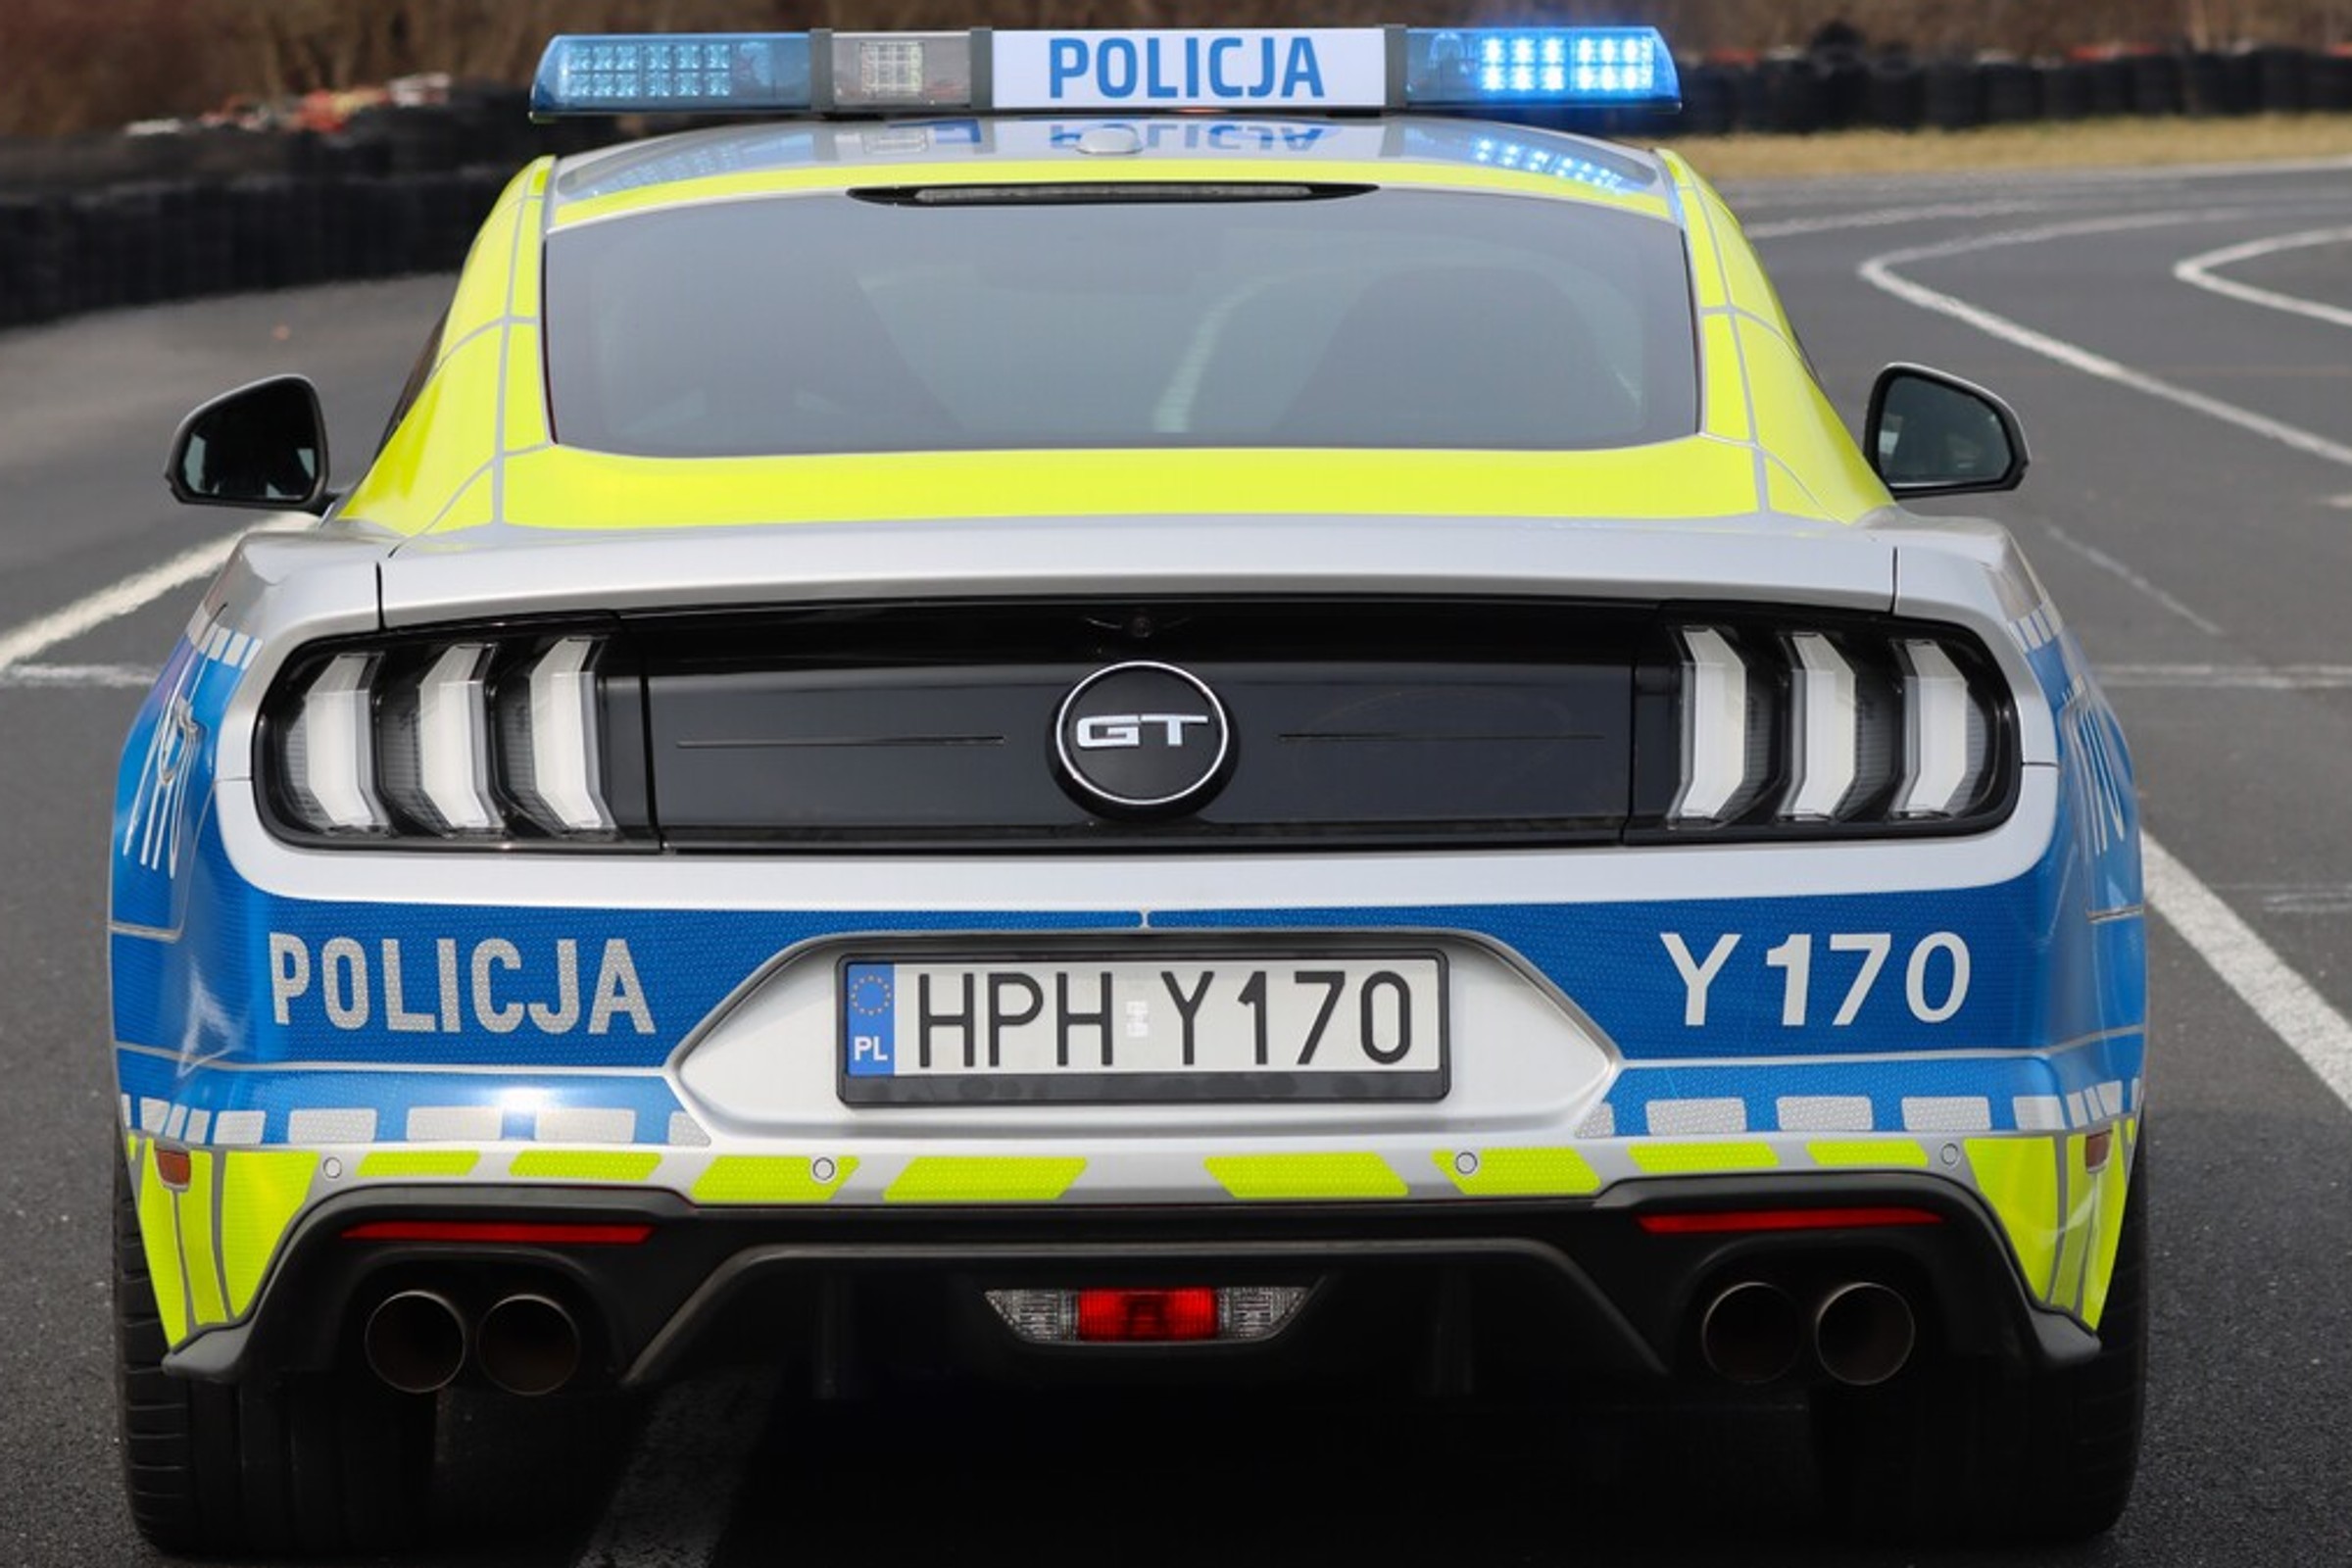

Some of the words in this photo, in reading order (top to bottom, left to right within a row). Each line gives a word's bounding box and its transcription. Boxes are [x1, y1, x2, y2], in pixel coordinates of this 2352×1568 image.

[1050, 37, 1325, 98] POLICJA
[1077, 714, 1209, 748] GT
[269, 932, 656, 1034] POLICJA
[854, 1037, 888, 1061] PL
[918, 971, 1113, 1067] HPH
[1160, 970, 1412, 1064] Y170
